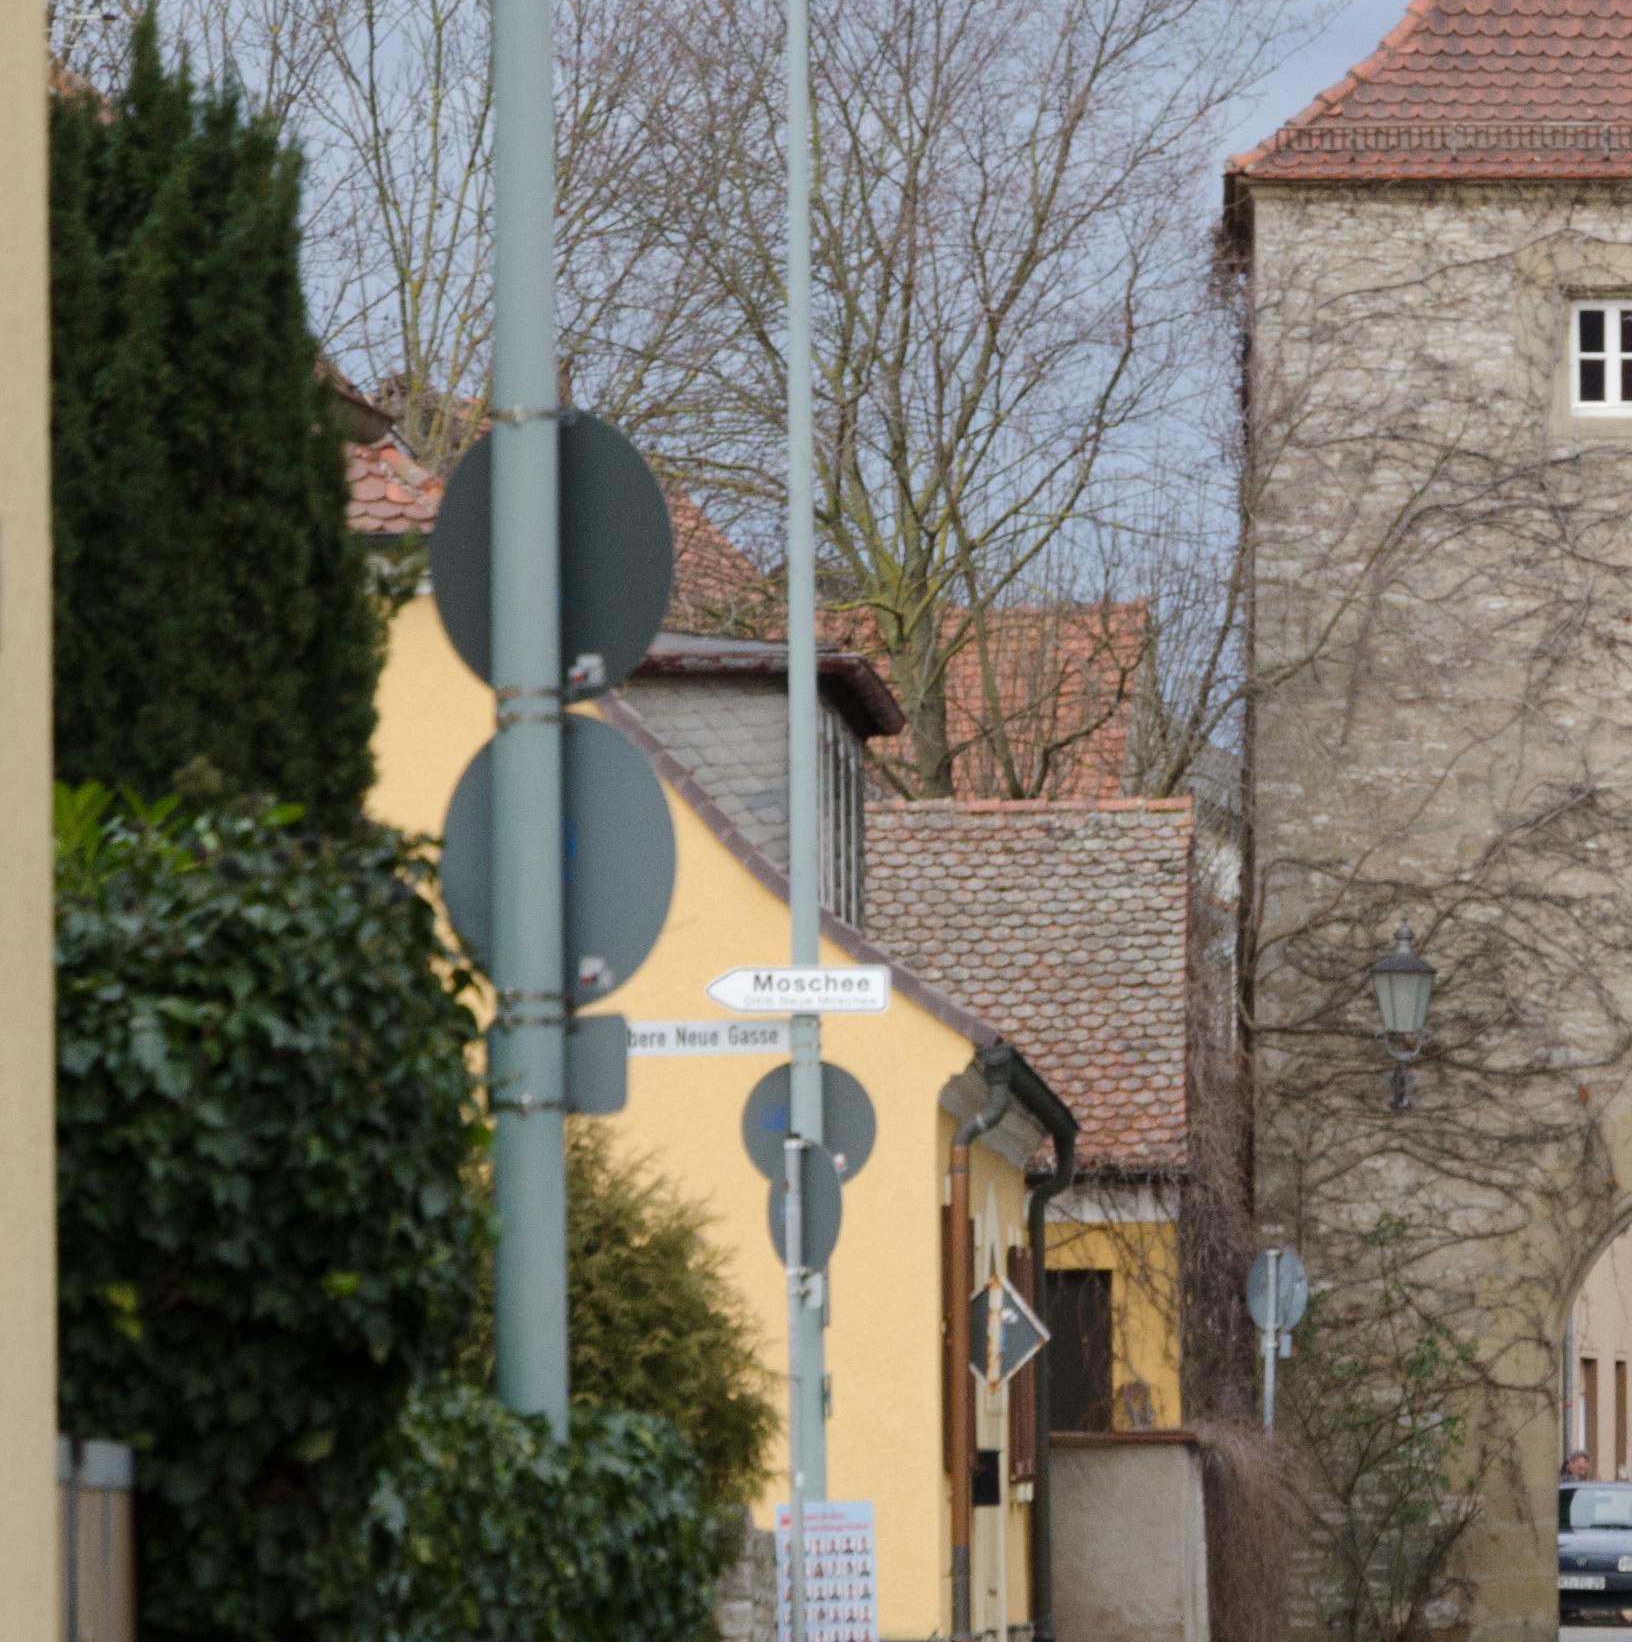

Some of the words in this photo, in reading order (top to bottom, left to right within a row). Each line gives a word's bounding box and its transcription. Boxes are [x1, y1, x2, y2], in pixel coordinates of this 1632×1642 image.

[753, 973, 870, 993] Moschee
[627, 1027, 666, 1048] bere
[676, 1026, 719, 1047] Neue
[728, 1024, 779, 1046] Gasse
